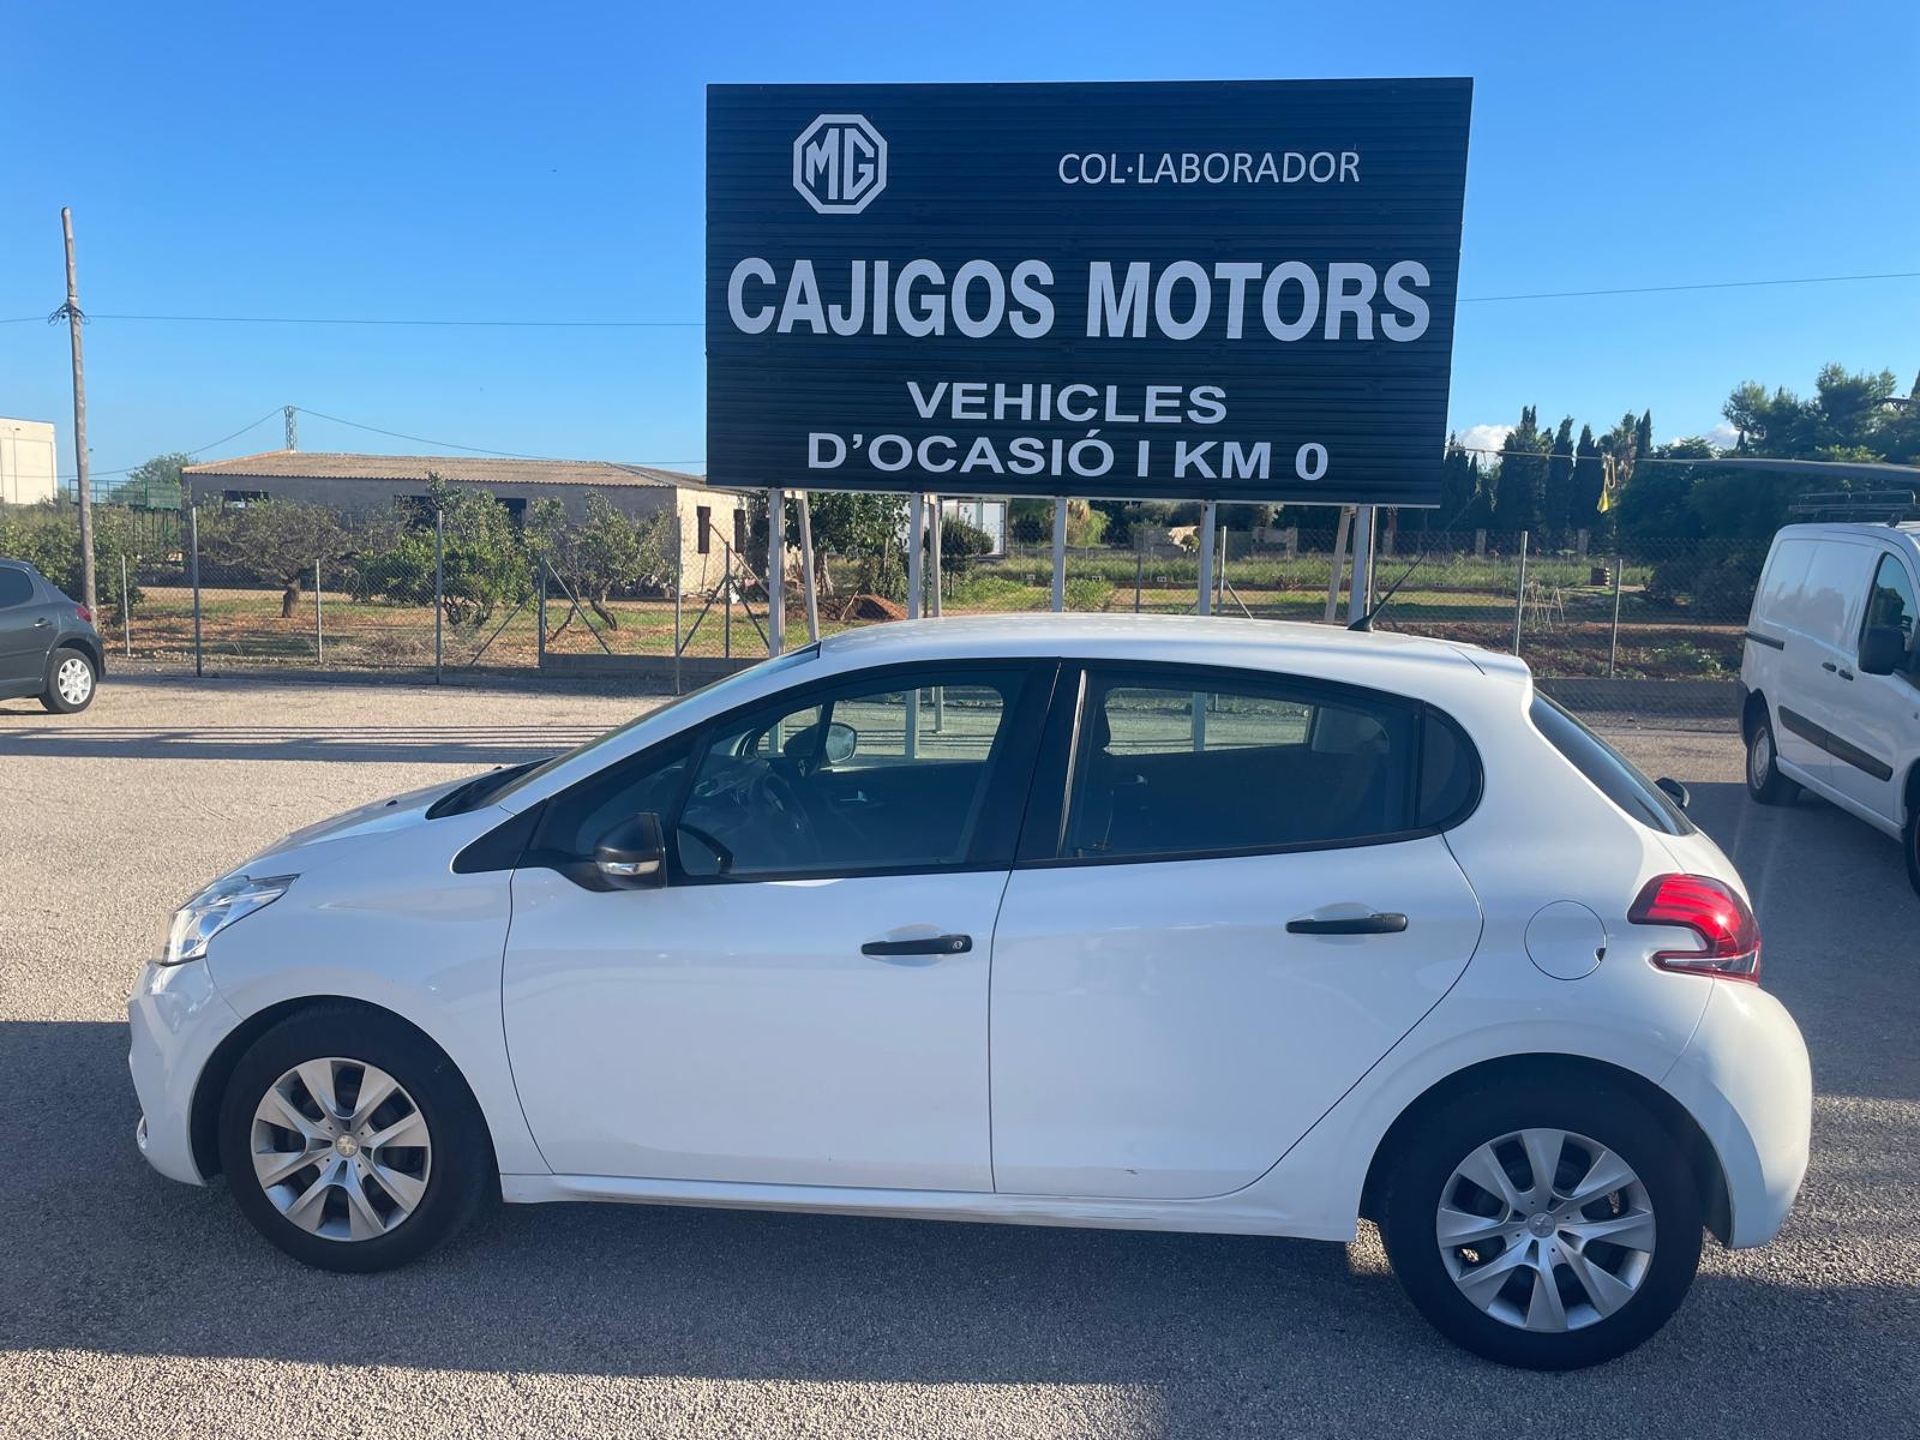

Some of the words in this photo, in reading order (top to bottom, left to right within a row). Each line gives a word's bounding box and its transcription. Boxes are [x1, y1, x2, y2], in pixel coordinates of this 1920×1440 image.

[804, 126, 877, 201] MG
[1058, 151, 1361, 185] COL·LABORADOR
[727, 257, 1055, 339] CAJIGOS
[1086, 260, 1431, 342] MOTORS
[906, 381, 1228, 424] VEHICLES
[1137, 440, 1150, 477] I
[1174, 441, 1271, 479] KM
[1295, 443, 1329, 481] 0
